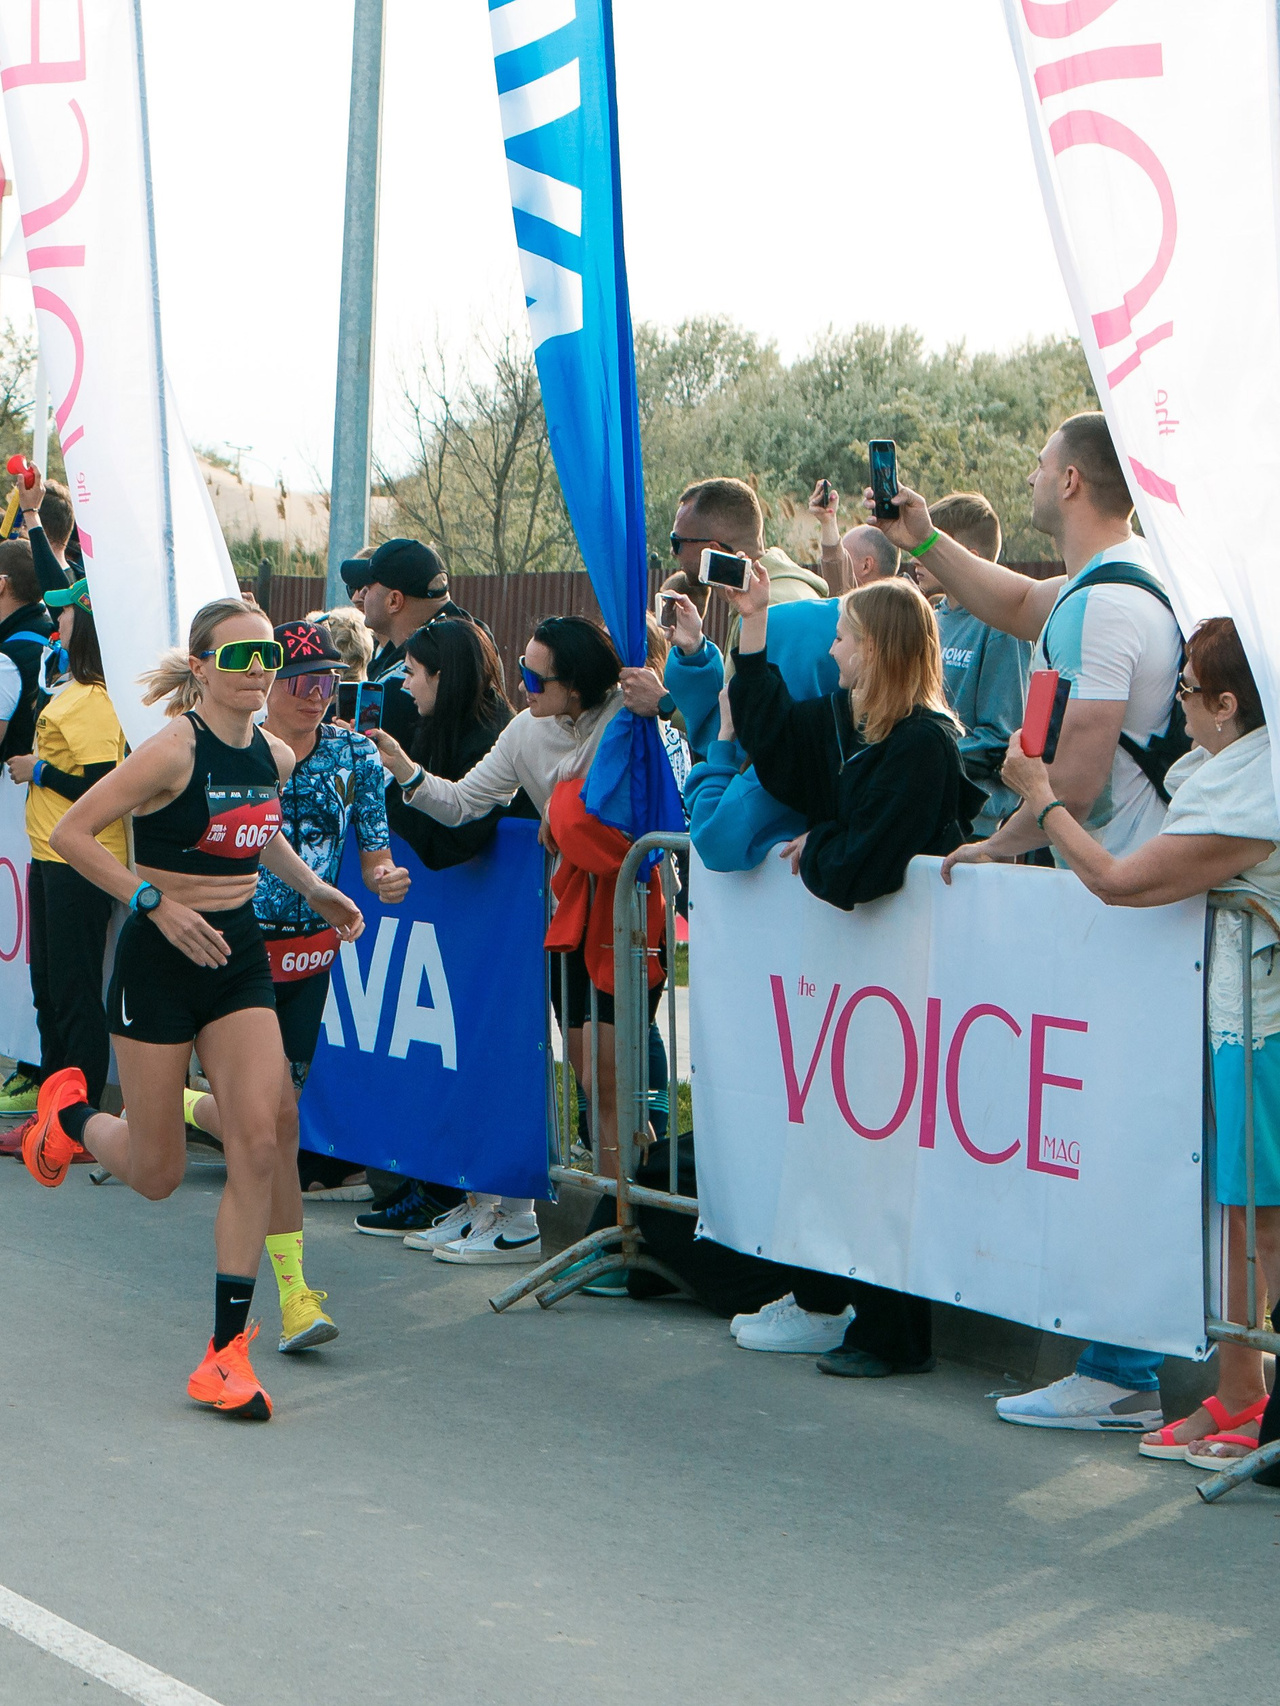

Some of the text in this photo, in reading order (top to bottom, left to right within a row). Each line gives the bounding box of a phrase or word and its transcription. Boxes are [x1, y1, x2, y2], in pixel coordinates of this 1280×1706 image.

[235, 824, 279, 849] 6067
[281, 949, 335, 972] 6090
[797, 974, 816, 998] the
[769, 974, 1089, 1180] VOICE
[1043, 1134, 1081, 1165] MAG
